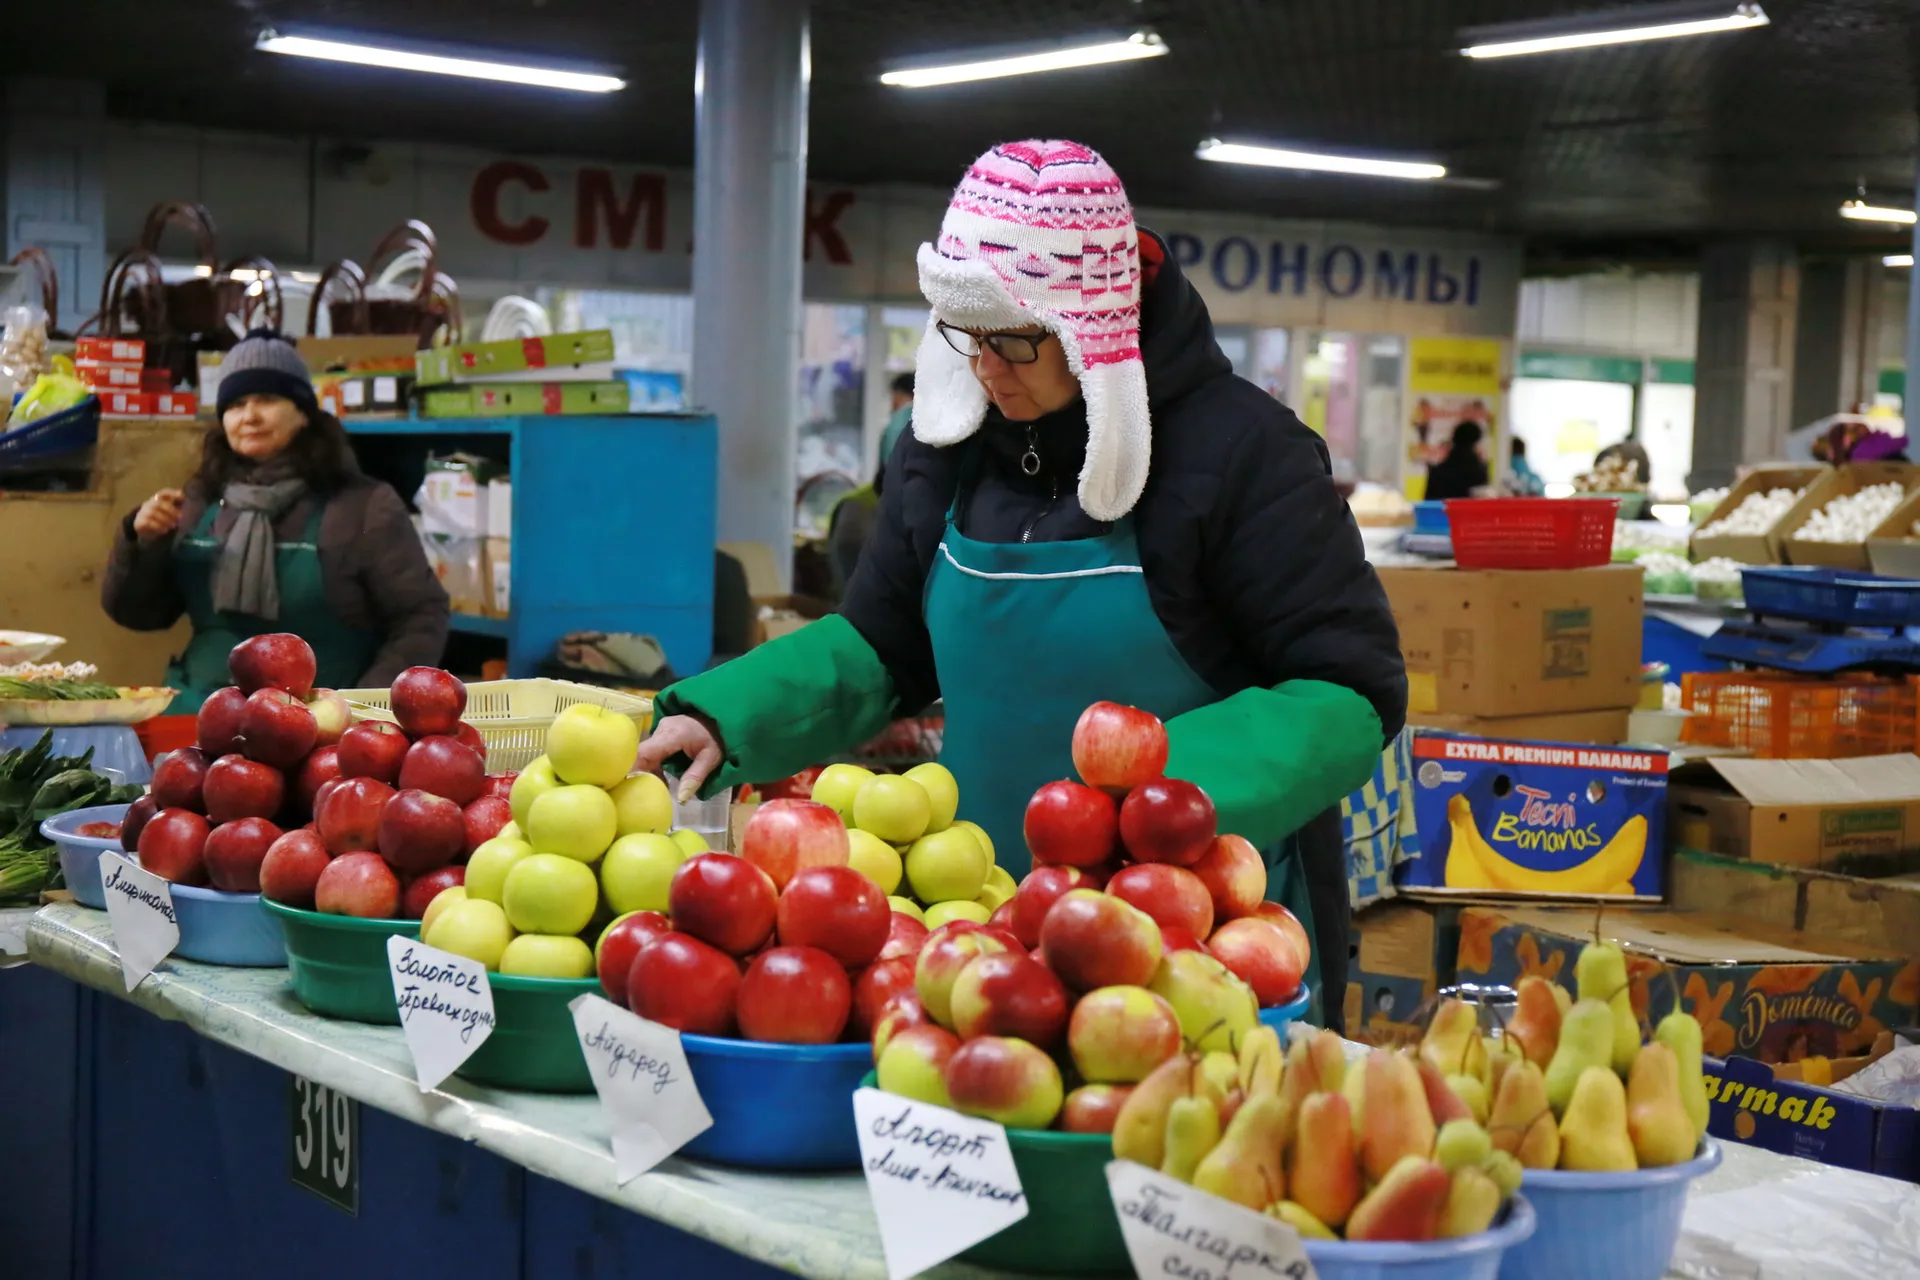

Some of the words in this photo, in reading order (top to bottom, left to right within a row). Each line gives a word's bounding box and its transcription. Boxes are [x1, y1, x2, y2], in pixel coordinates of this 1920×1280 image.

[470, 160, 856, 266] СМК
[1446, 742, 1500, 761] EXTRA
[1503, 745, 1575, 766] PREMIUM
[1578, 750, 1652, 771] BANANAS
[1515, 784, 1576, 829] Tecni
[1492, 812, 1602, 852] Bananas
[396, 947, 482, 995] Золотое
[295, 1073, 350, 1189] 319
[872, 1107, 995, 1159] Апорт
